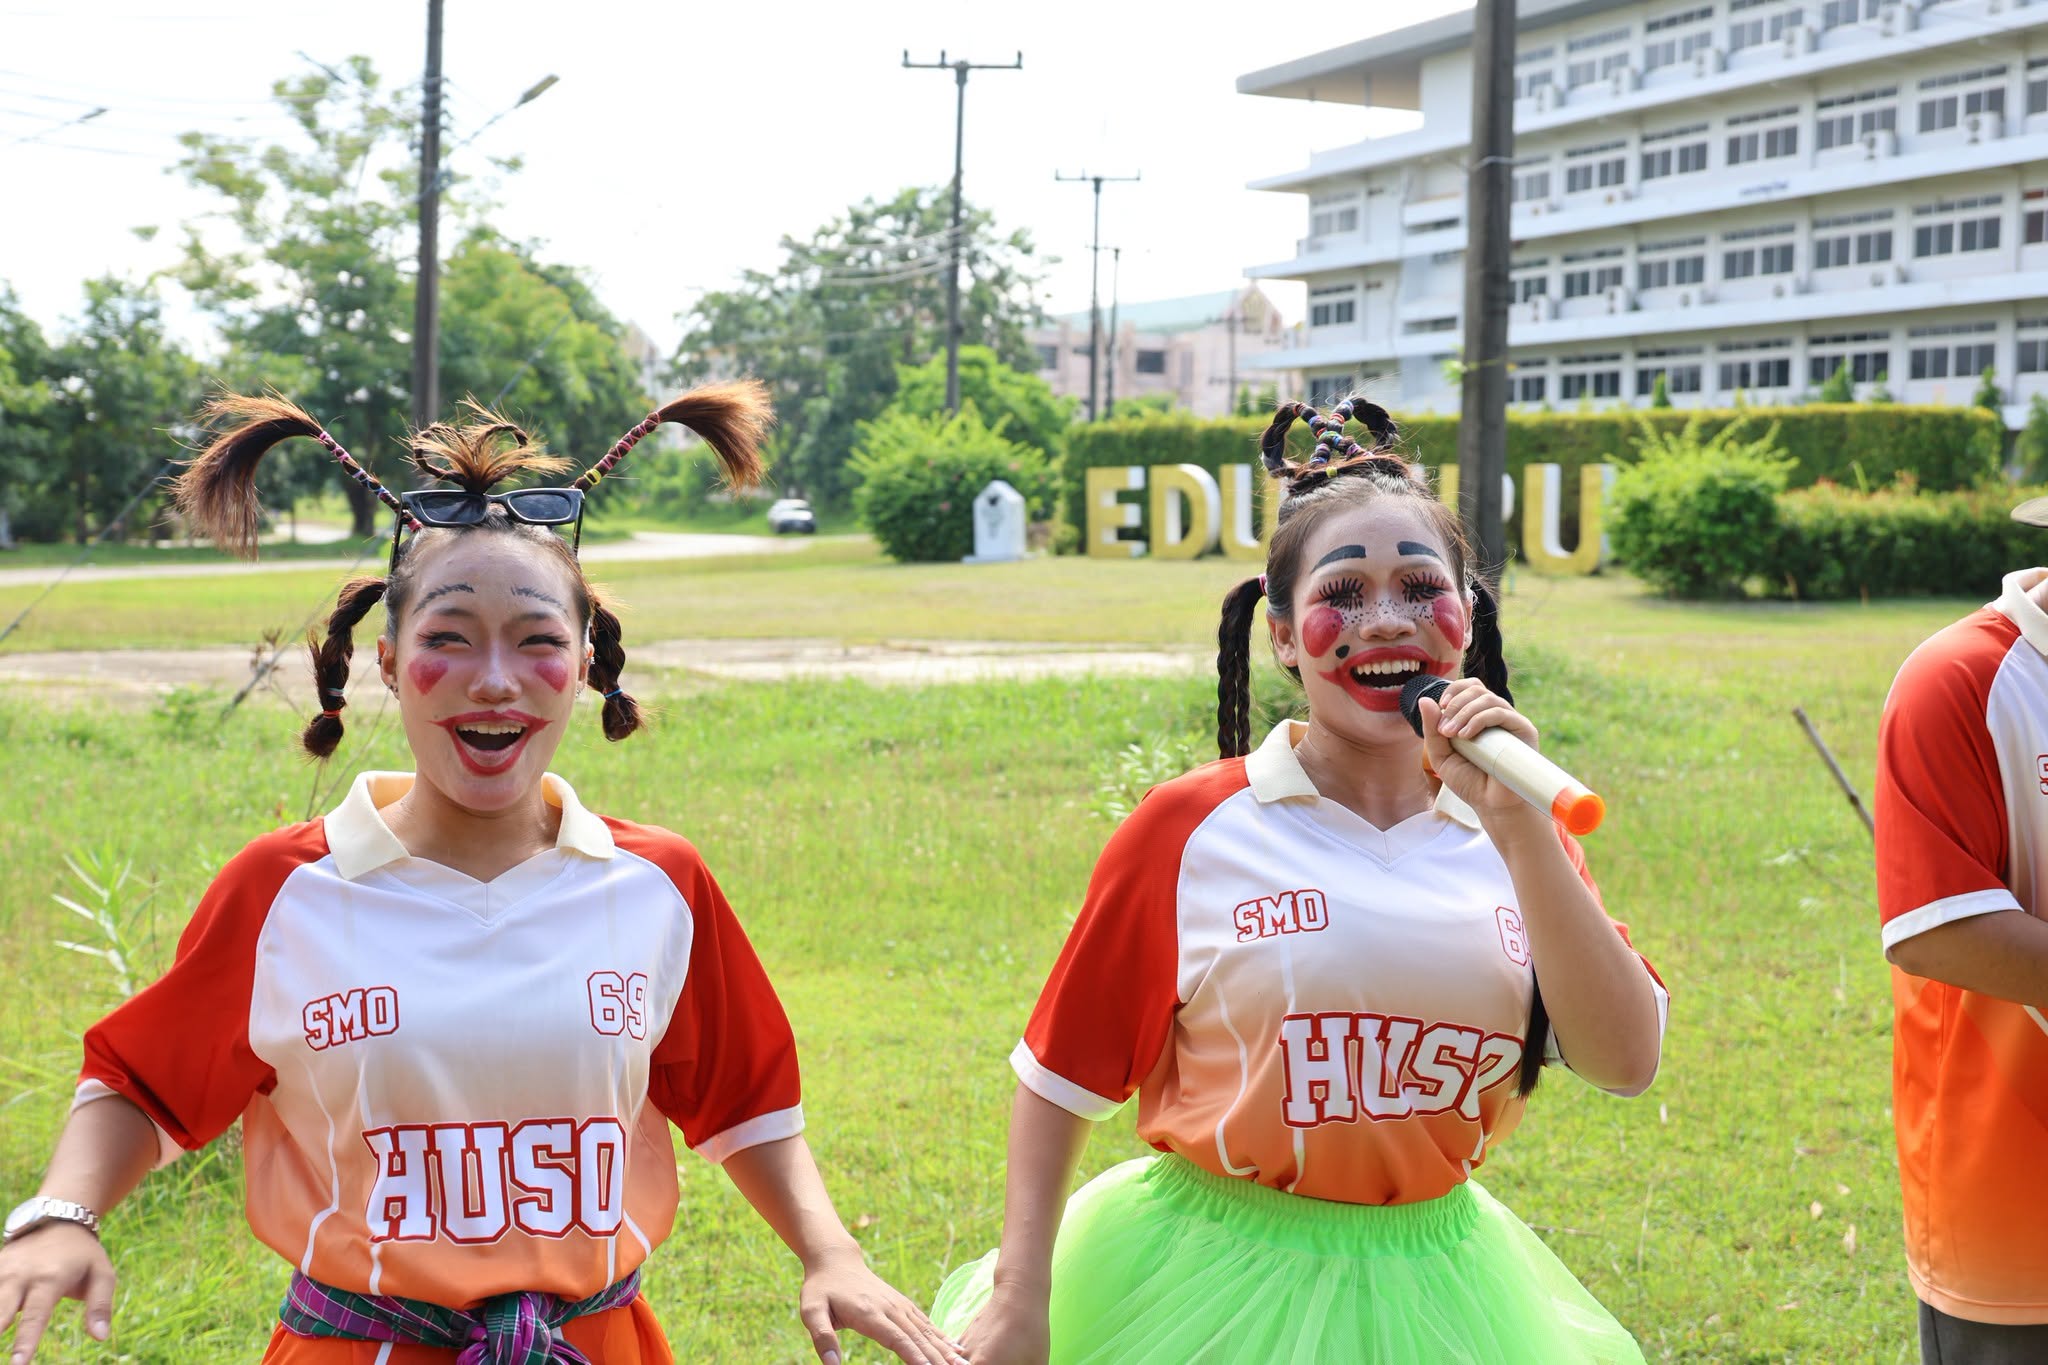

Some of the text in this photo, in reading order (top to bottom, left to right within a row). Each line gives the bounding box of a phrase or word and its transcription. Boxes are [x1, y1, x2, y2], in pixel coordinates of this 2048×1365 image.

[1233, 889, 1329, 943] SMO
[1495, 906, 1531, 966] 6
[303, 986, 399, 1051] SMO
[587, 971, 648, 1040] 69
[362, 1117, 626, 1245] HUSO
